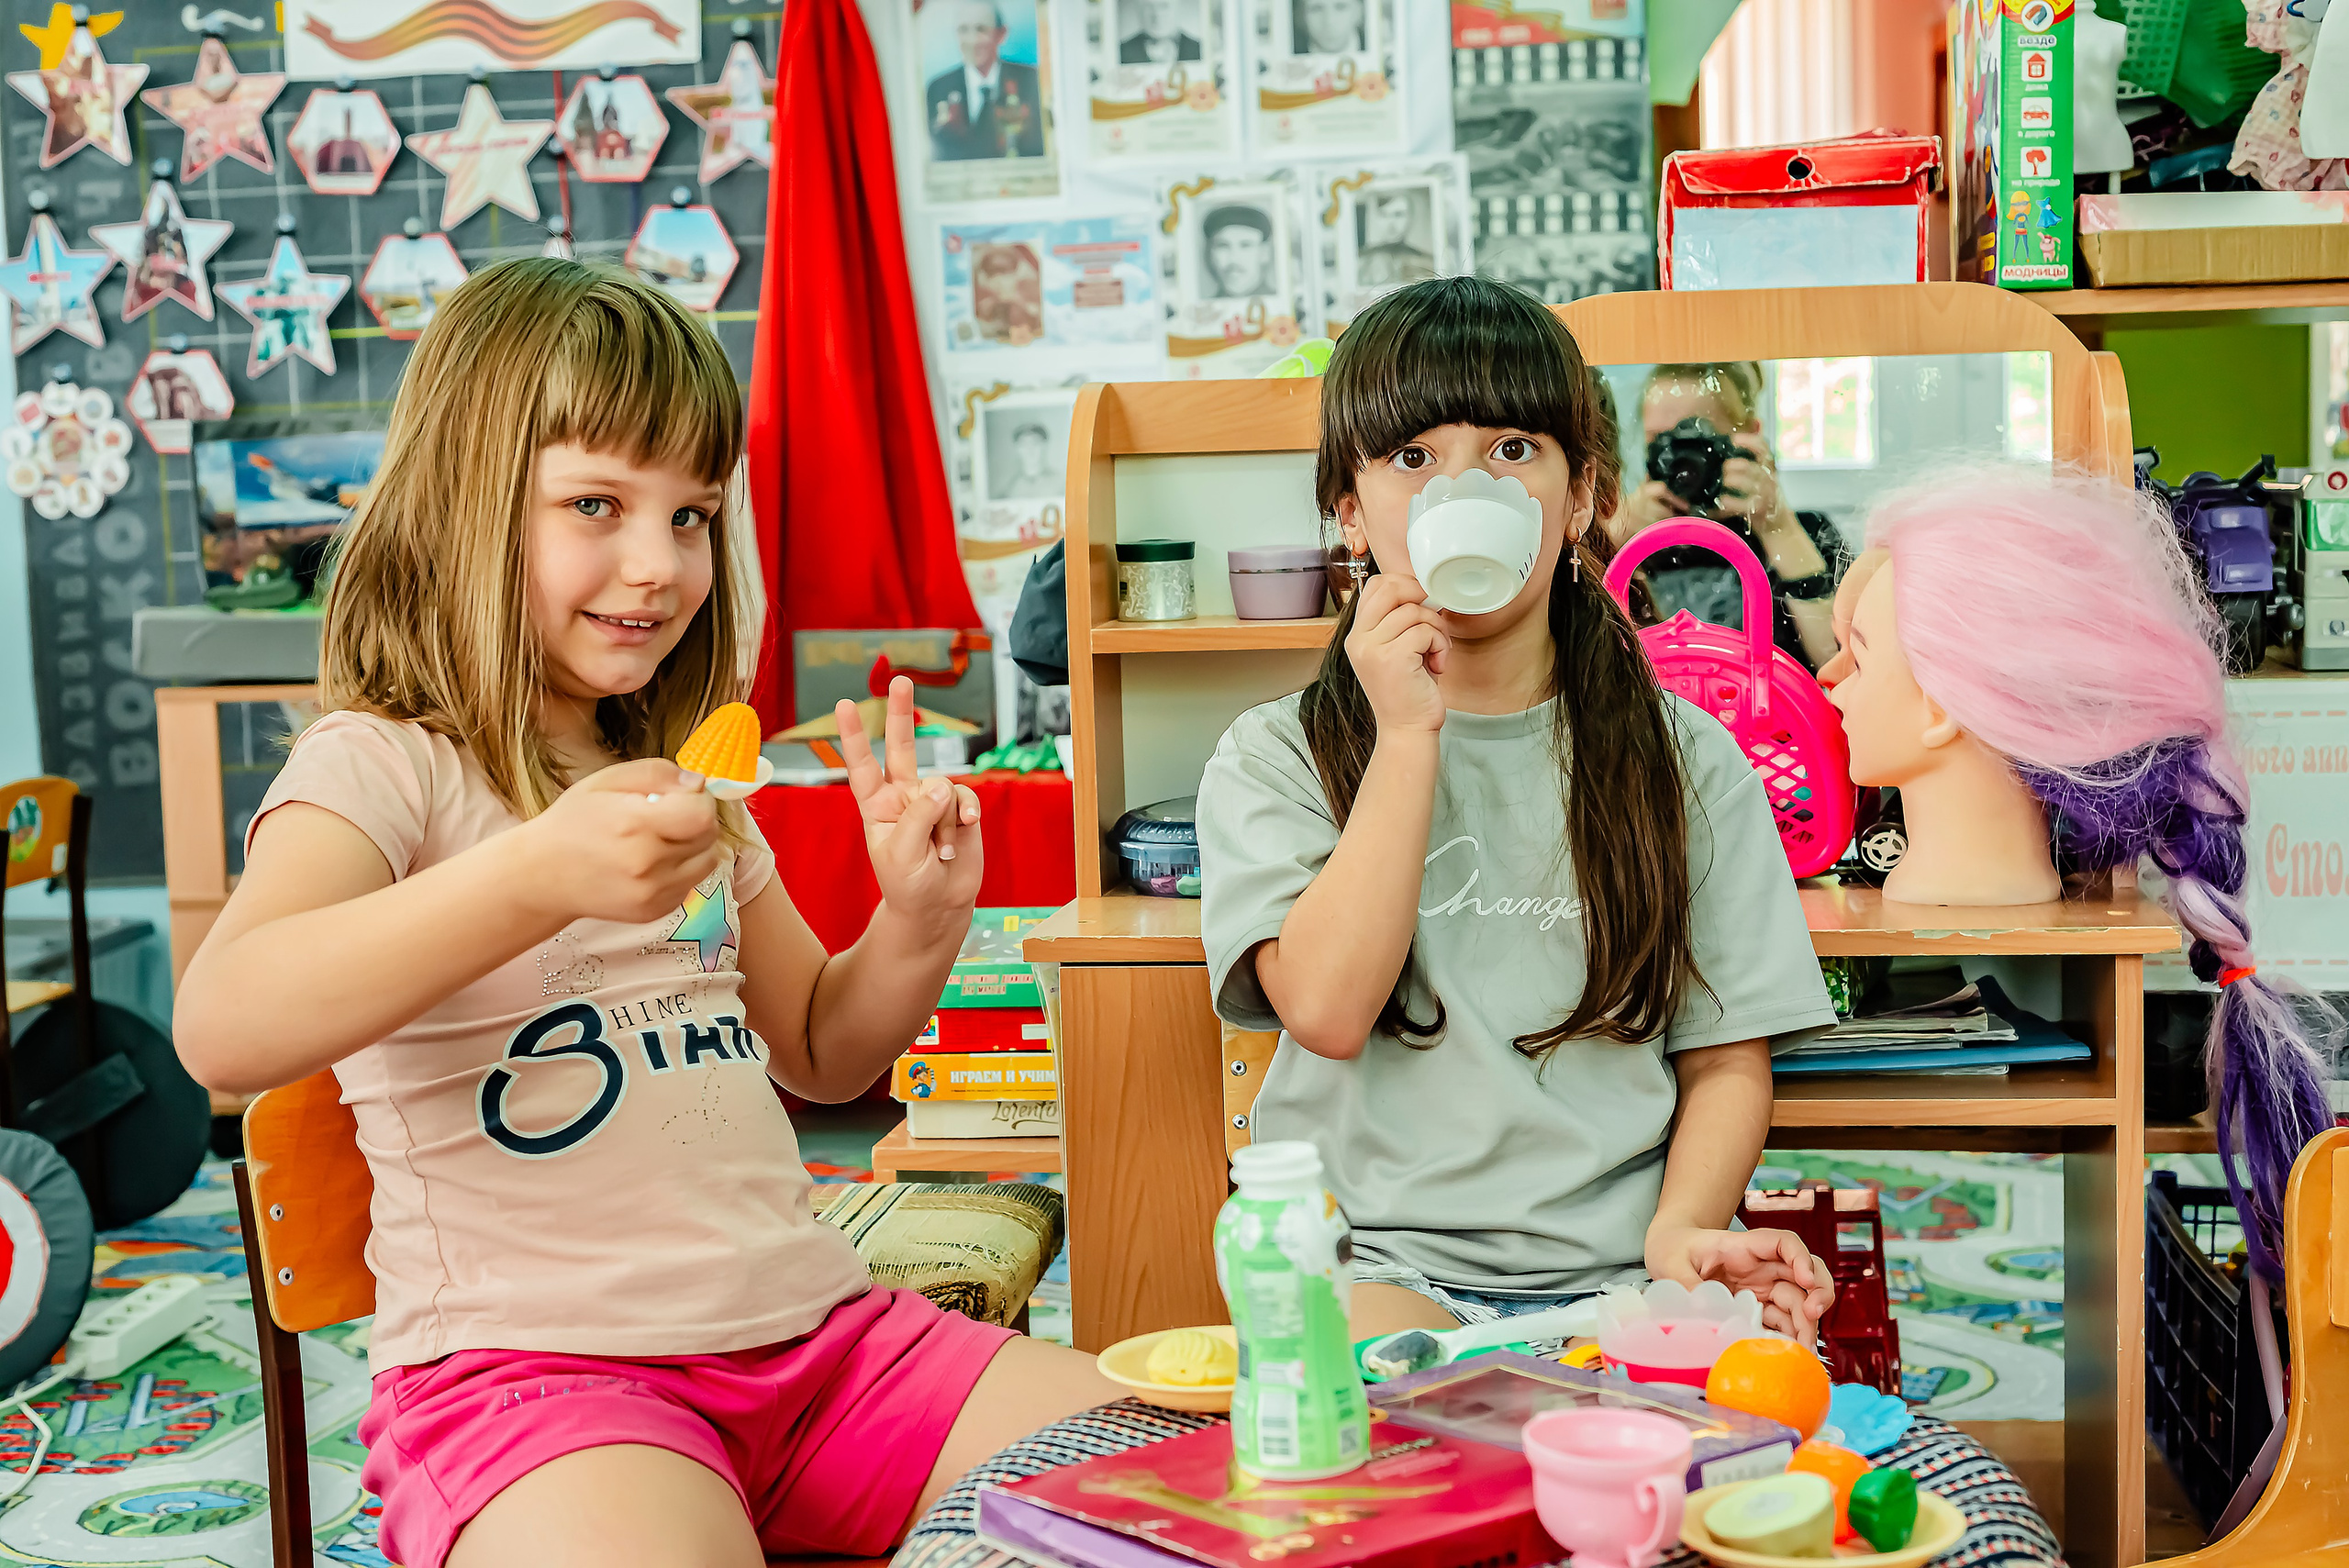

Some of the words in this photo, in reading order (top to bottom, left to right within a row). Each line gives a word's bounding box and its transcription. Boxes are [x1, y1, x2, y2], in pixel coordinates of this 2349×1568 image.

[2003, 266, 2067, 279] МОДНИЦЫ
[2266, 822, 2349, 898] Сто
[950, 1070, 1002, 1084] ИГРАЕМ
[1006, 1070, 1016, 1083] И
